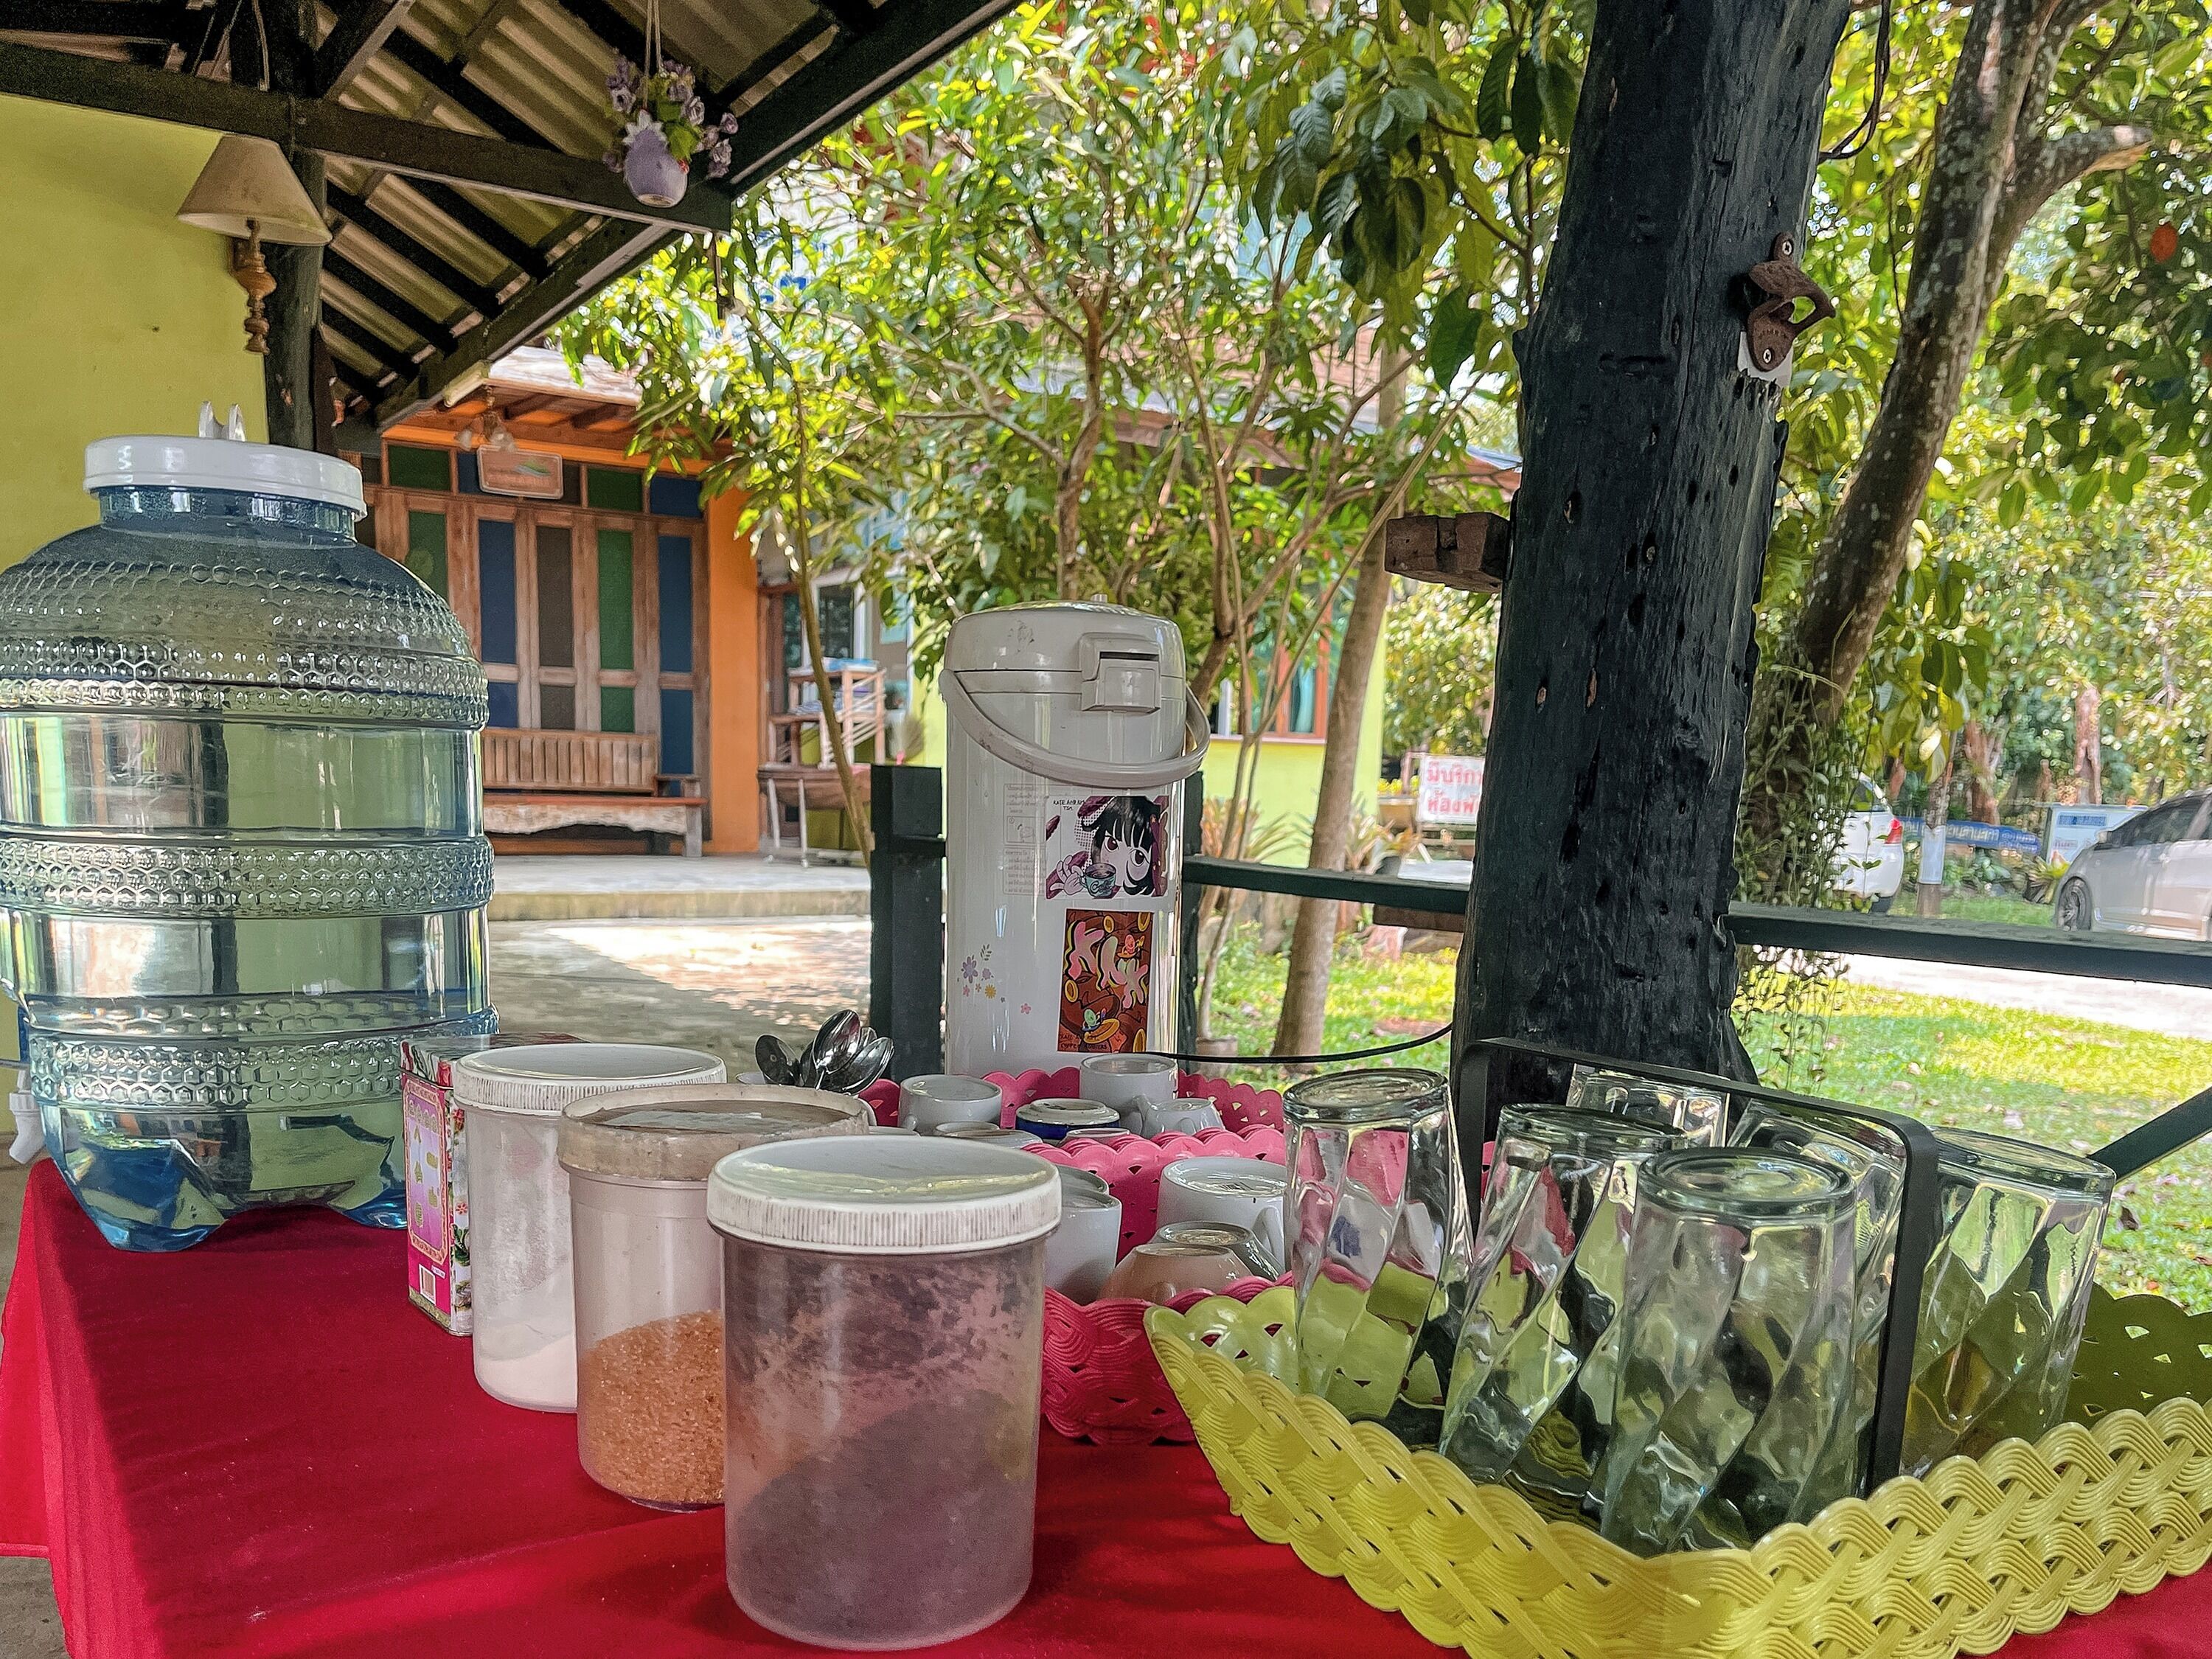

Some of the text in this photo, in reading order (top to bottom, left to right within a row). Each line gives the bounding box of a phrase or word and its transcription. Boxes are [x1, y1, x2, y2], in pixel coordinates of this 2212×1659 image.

[1427, 761, 1482, 784] มีบริกา
[1427, 787, 1480, 813] ห้องพั
